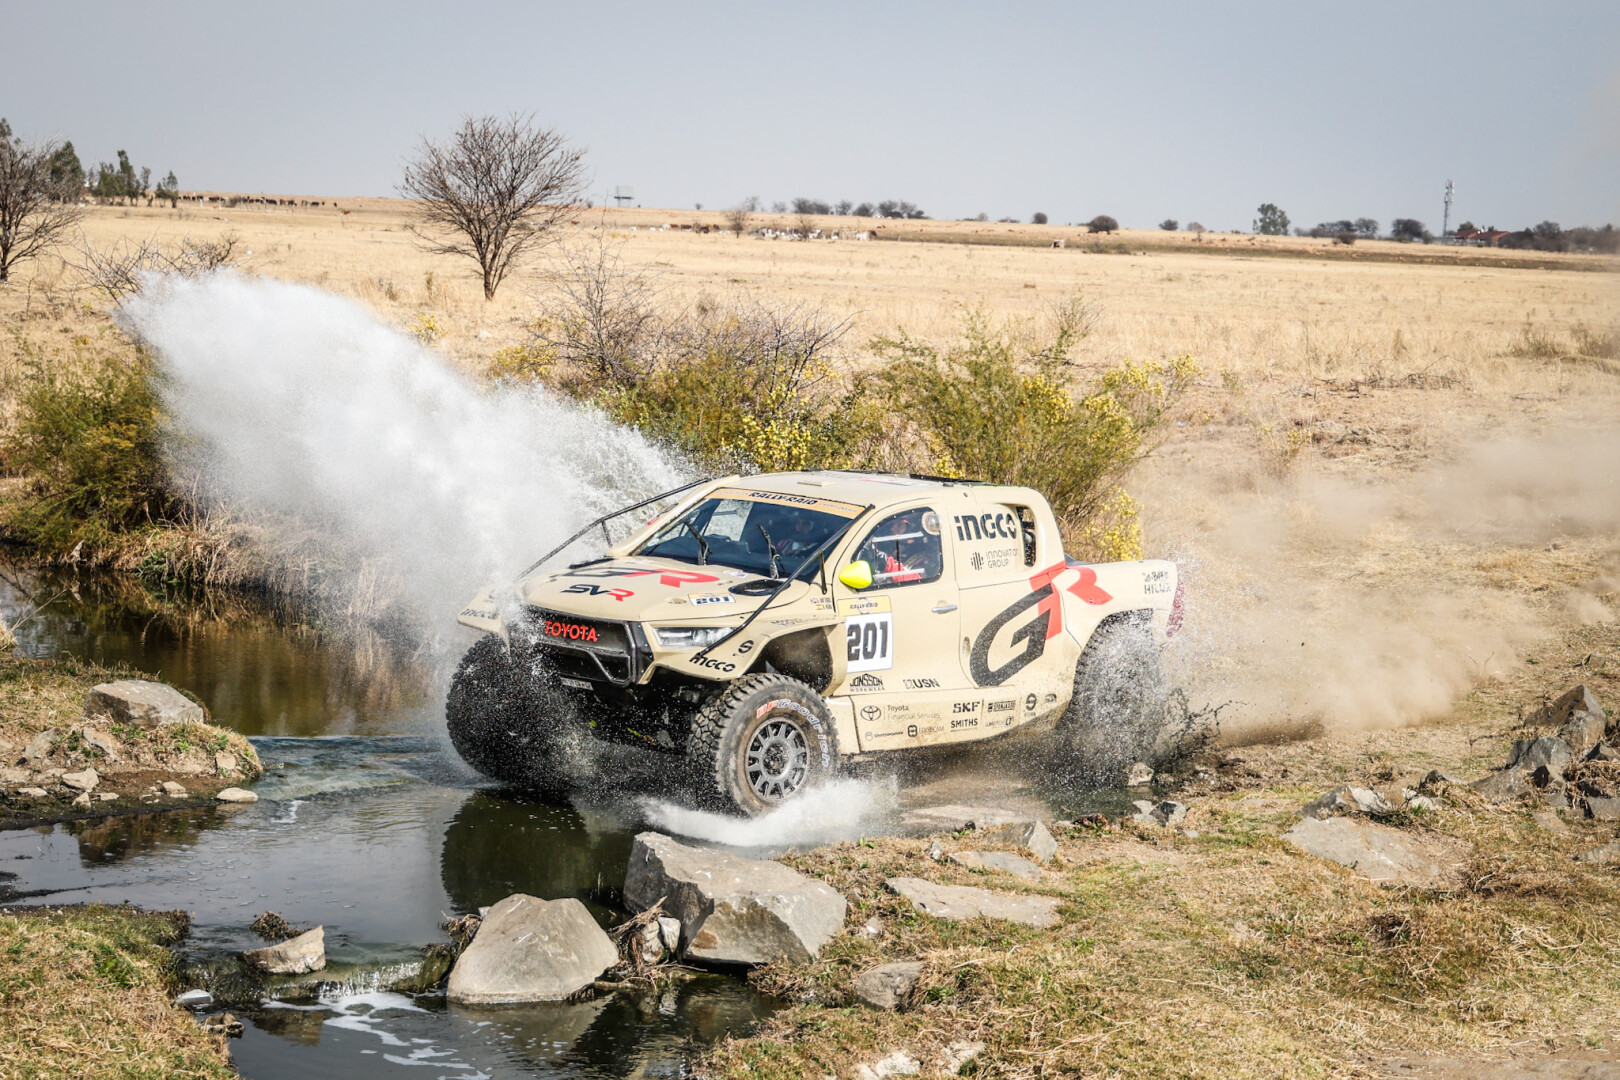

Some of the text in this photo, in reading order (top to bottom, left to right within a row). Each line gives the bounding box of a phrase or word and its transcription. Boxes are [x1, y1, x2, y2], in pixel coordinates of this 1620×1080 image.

[987, 558, 1009, 568] GROUP
[560, 583, 634, 602] SVR
[696, 596, 730, 605] 201
[544, 620, 598, 642] TOYOTA
[847, 621, 888, 662] 201
[849, 673, 884, 688] JONSSON
[912, 678, 941, 689] USN
[887, 705, 909, 713] Toyota
[953, 701, 981, 714] SKF
[950, 718, 979, 729] SMITHS
